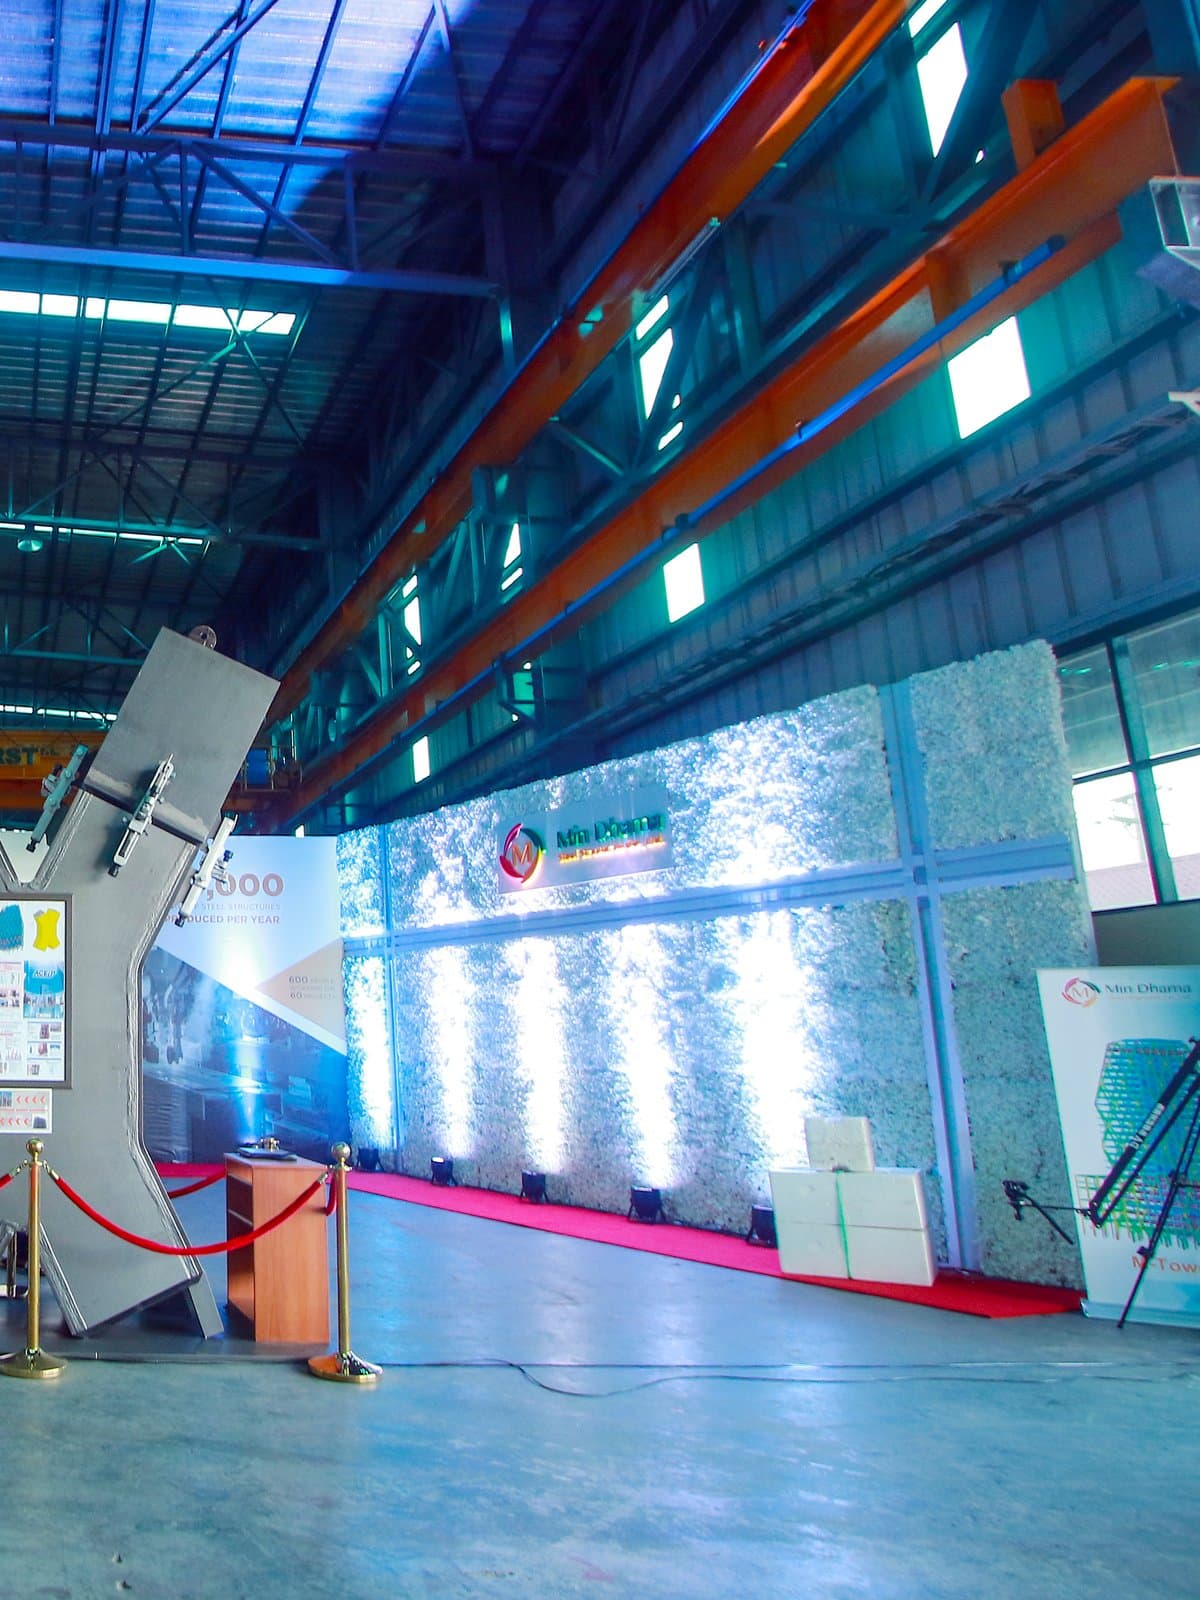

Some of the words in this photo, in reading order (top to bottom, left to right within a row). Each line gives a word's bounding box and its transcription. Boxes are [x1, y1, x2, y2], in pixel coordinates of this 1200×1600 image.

[556, 825, 590, 851] Min
[593, 814, 667, 843] Dhama
[165, 914, 224, 924] PRDUCED
[226, 915, 248, 924] PER
[250, 915, 280, 924] YEAR
[1104, 983, 1133, 994] Min
[1136, 982, 1192, 994] Dhama
